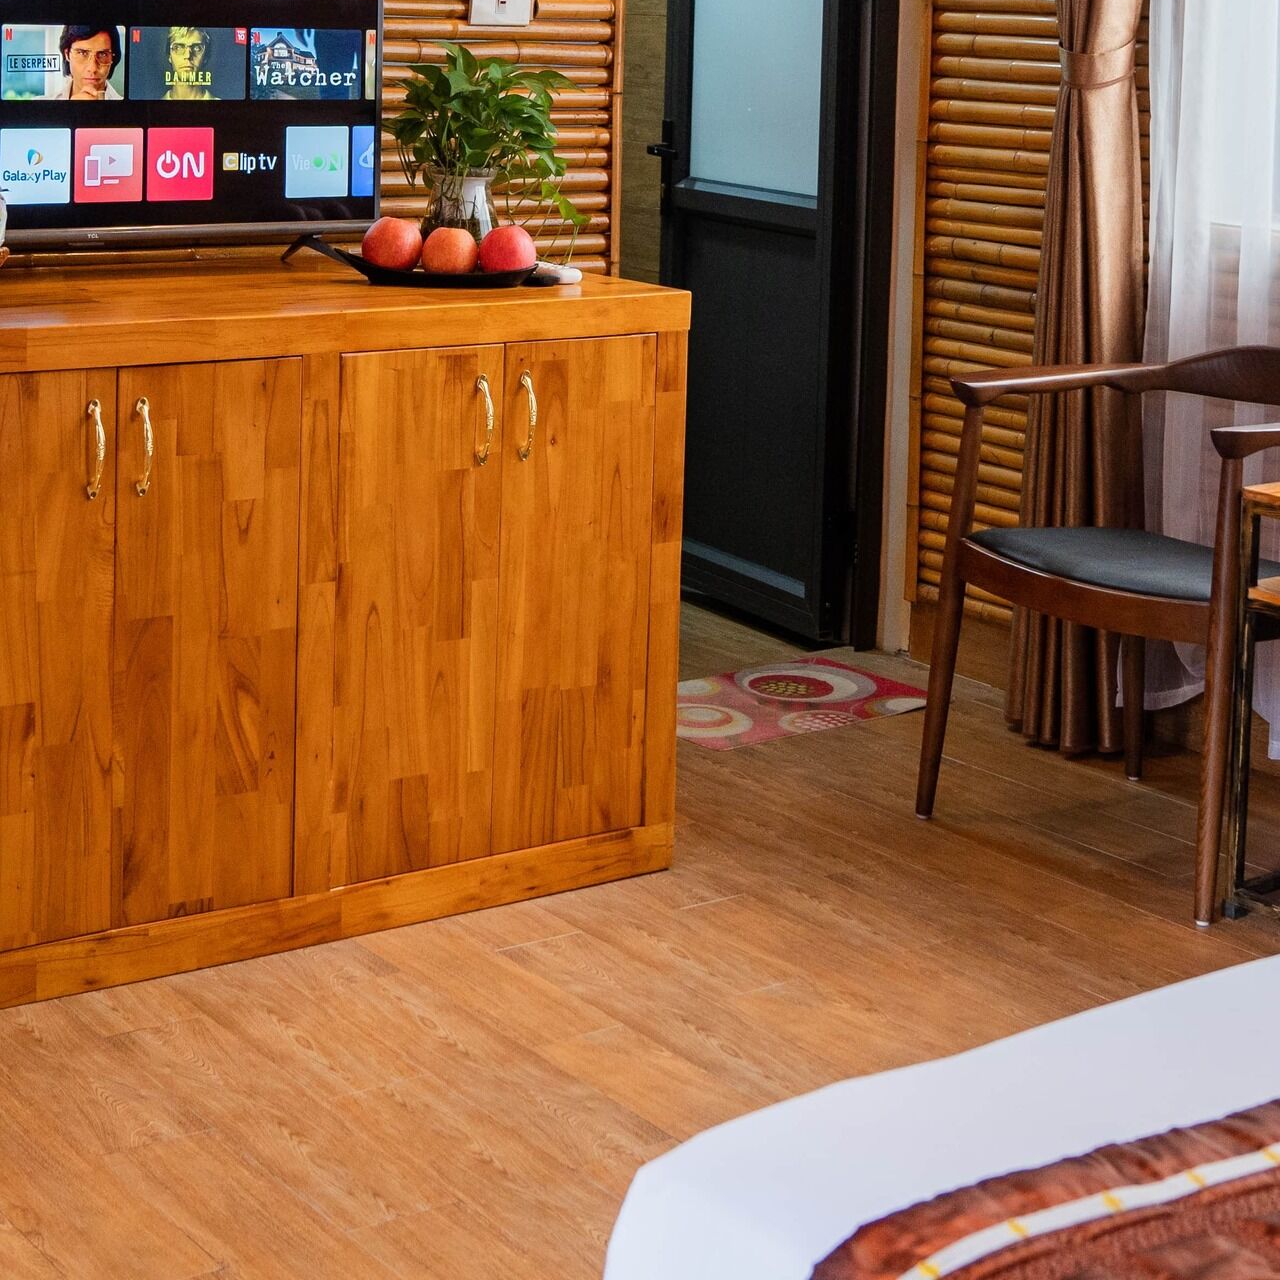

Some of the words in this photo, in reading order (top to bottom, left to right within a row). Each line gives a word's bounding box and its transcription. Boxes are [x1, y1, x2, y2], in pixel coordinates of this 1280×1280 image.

[9, 57, 19, 69] LE
[21, 57, 58, 69] SERPENT
[271, 62, 285, 70] The
[165, 71, 212, 82] DAHMER
[254, 61, 357, 87] Watcher
[156, 150, 205, 179] ON
[258, 153, 277, 170] tv
[3, 170, 42, 184] Galaxy
[43, 169, 66, 184] Play
